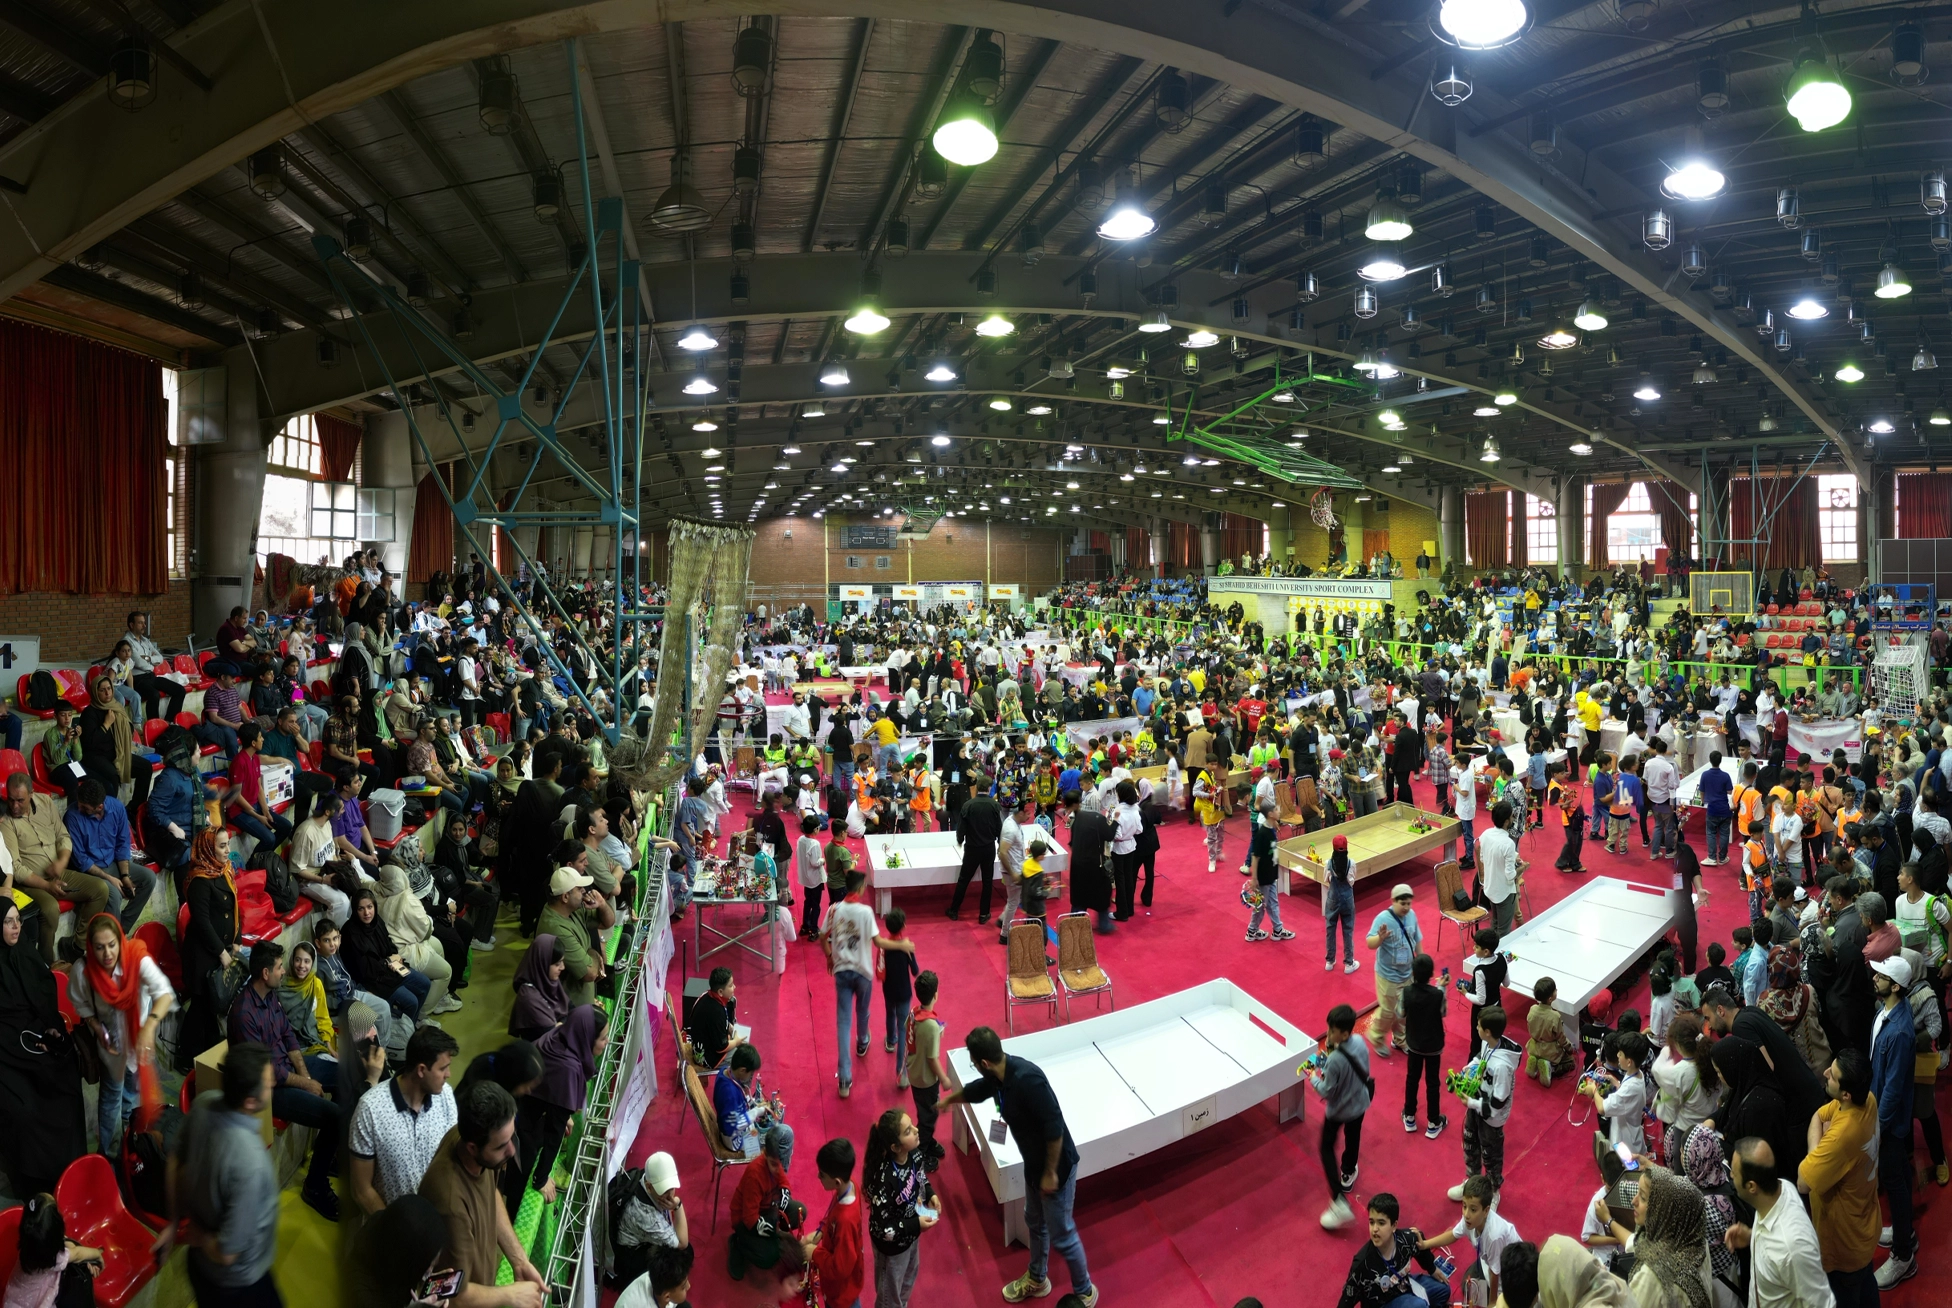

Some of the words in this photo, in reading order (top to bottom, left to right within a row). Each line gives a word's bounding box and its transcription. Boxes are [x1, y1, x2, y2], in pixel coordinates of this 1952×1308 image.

[1246, 582, 1275, 590] BEHESHTI
[1275, 583, 1313, 592] UNIVERSITY
[1314, 584, 1336, 593] SPORT
[1337, 586, 1374, 594] COMPLEX
[1195, 1107, 1209, 1121] زمین
